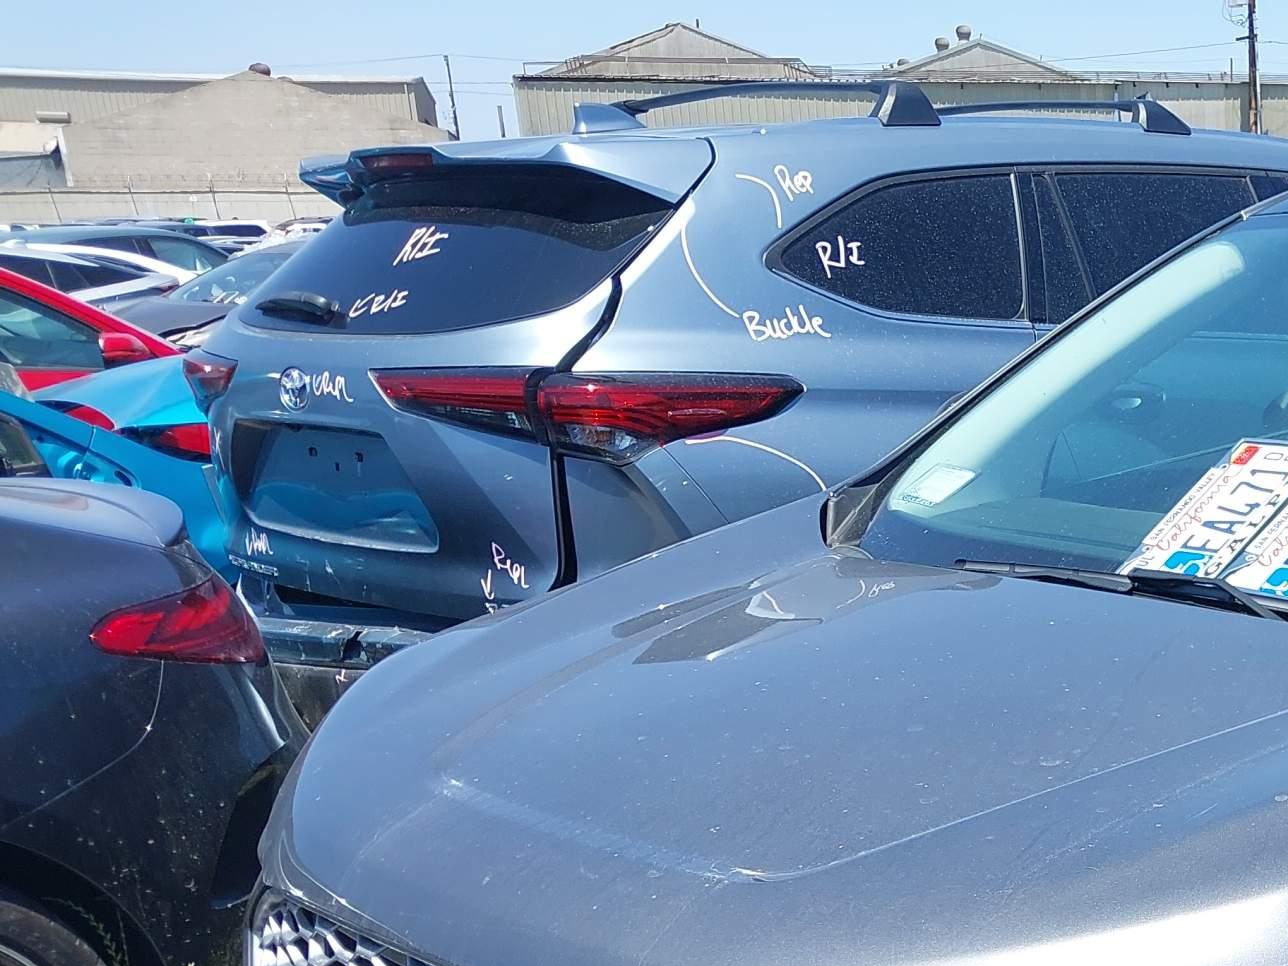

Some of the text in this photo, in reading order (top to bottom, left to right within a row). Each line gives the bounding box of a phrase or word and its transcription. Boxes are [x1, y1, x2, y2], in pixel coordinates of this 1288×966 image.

[815, 235, 865, 278] R/I
[742, 304, 832, 341] Buckle
[1155, 470, 1241, 551] California
